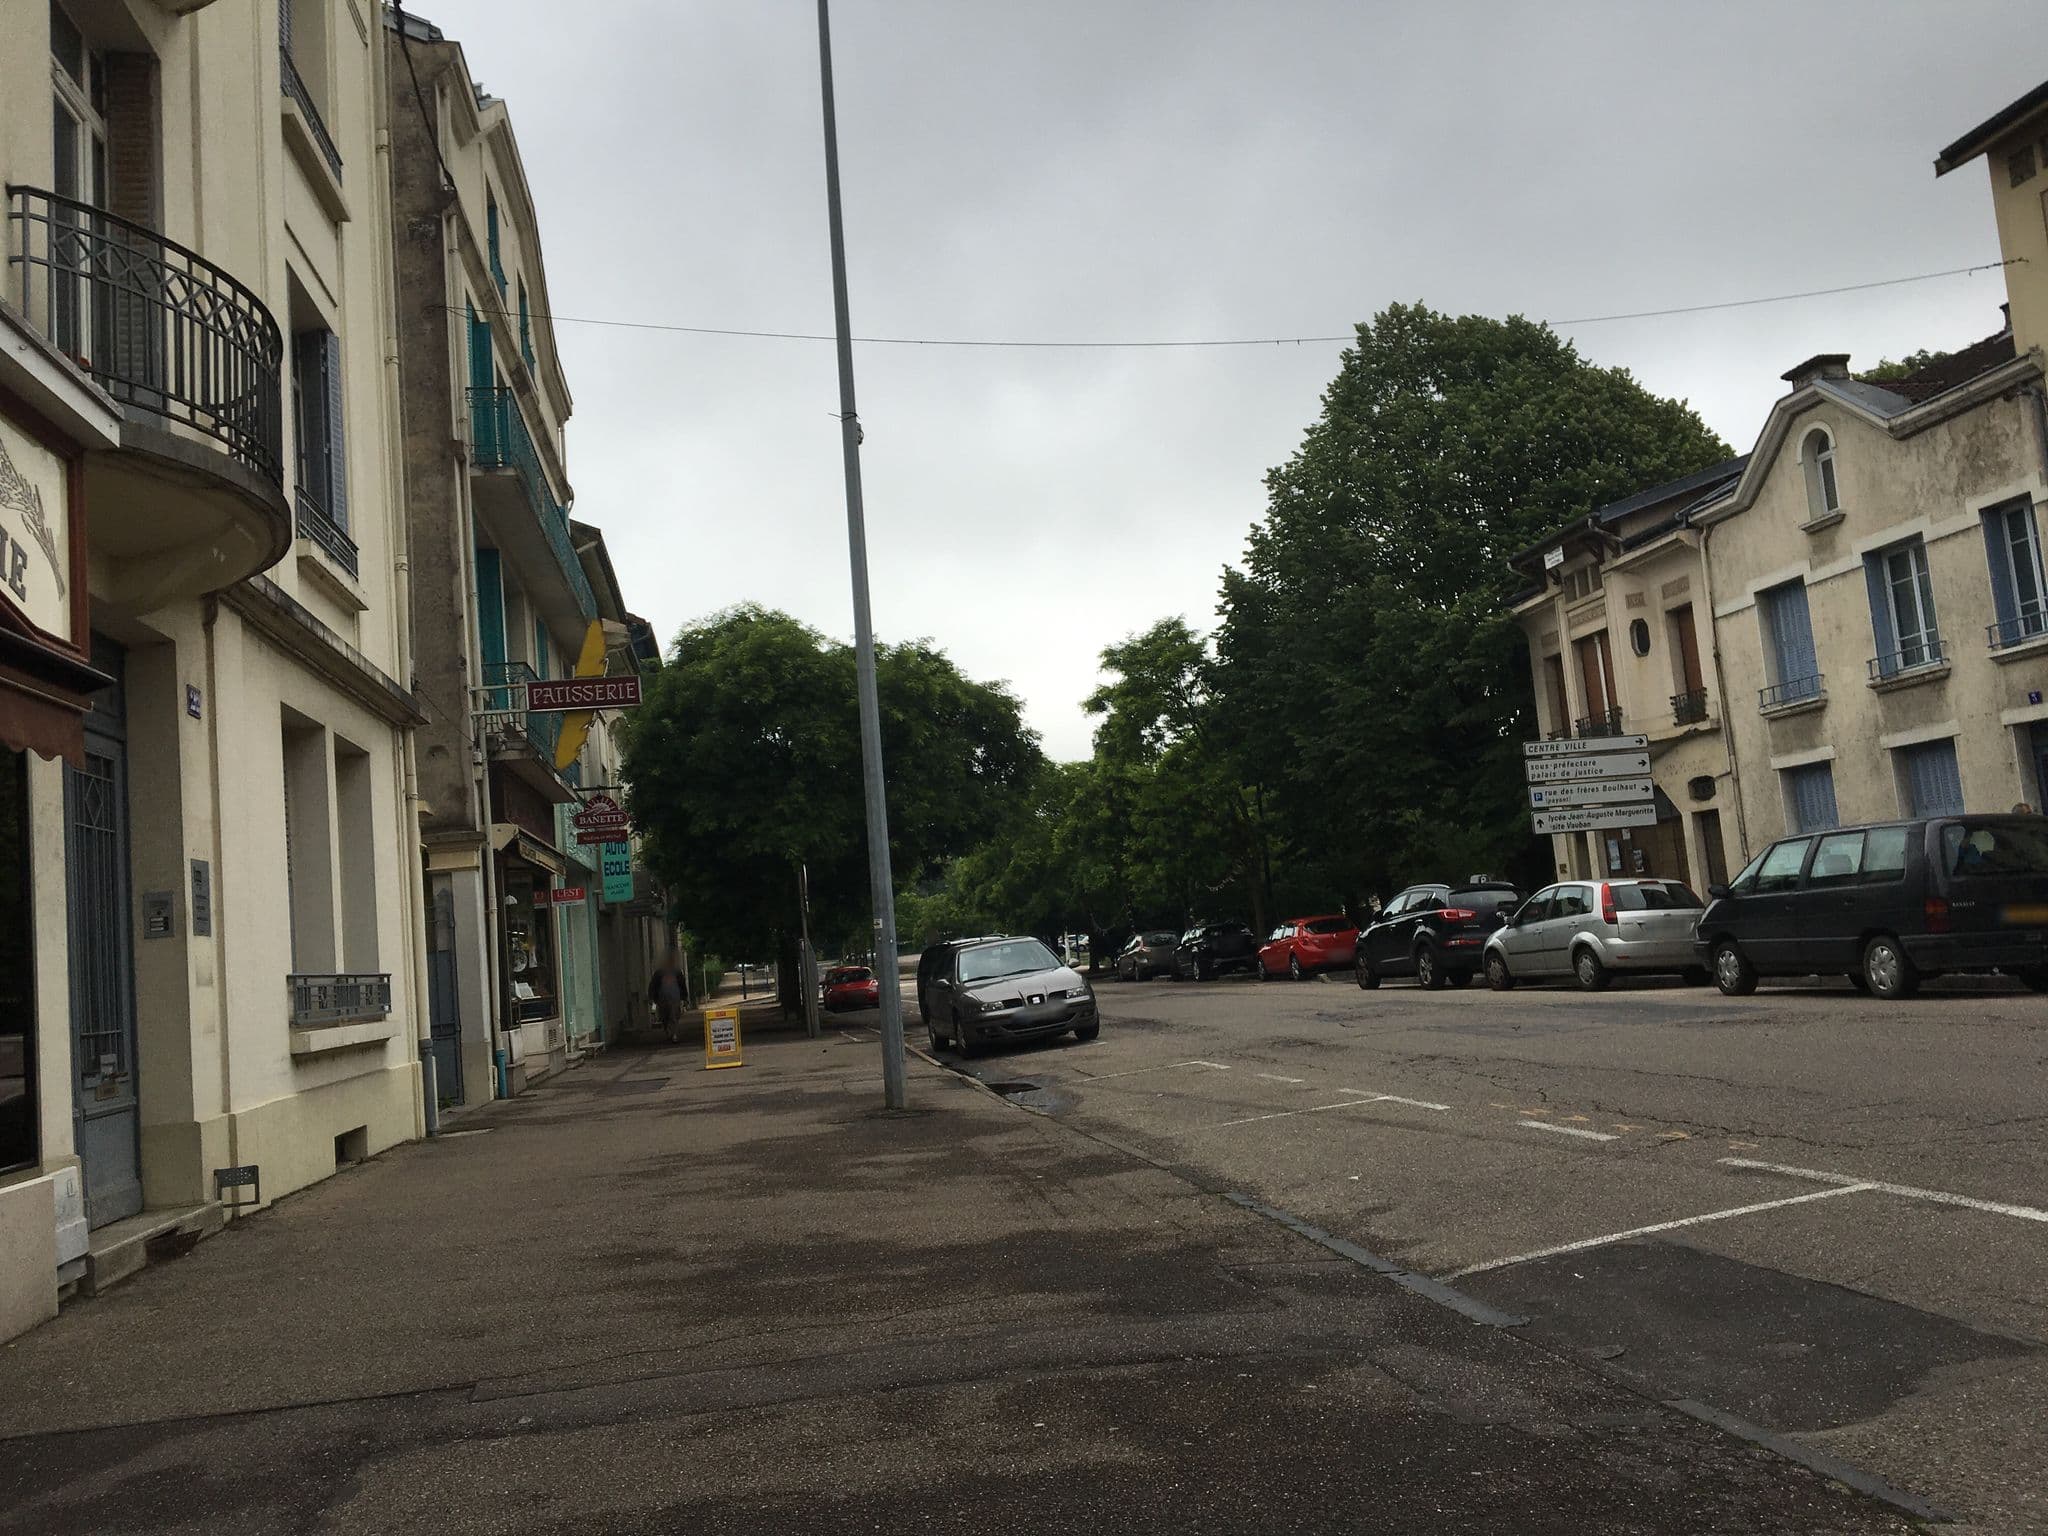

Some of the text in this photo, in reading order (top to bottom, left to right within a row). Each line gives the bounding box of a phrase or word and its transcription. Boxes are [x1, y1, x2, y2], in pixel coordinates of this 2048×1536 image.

[532, 682, 636, 705] PATISSERIE
[1528, 742, 1587, 753] CENTRE VILLE
[1530, 760, 1597, 771] sous-préfecture
[1530, 767, 1604, 780] palais de justice
[1544, 789, 1557, 797] rue
[1561, 787, 1574, 795] des
[579, 814, 624, 825] BANETTE
[1548, 814, 1566, 823] lycée
[1567, 809, 1614, 821] Jean-Auguste
[1566, 820, 1592, 829] Vauban
[605, 842, 627, 856] AUTO
[604, 860, 631, 877] ECOLE
